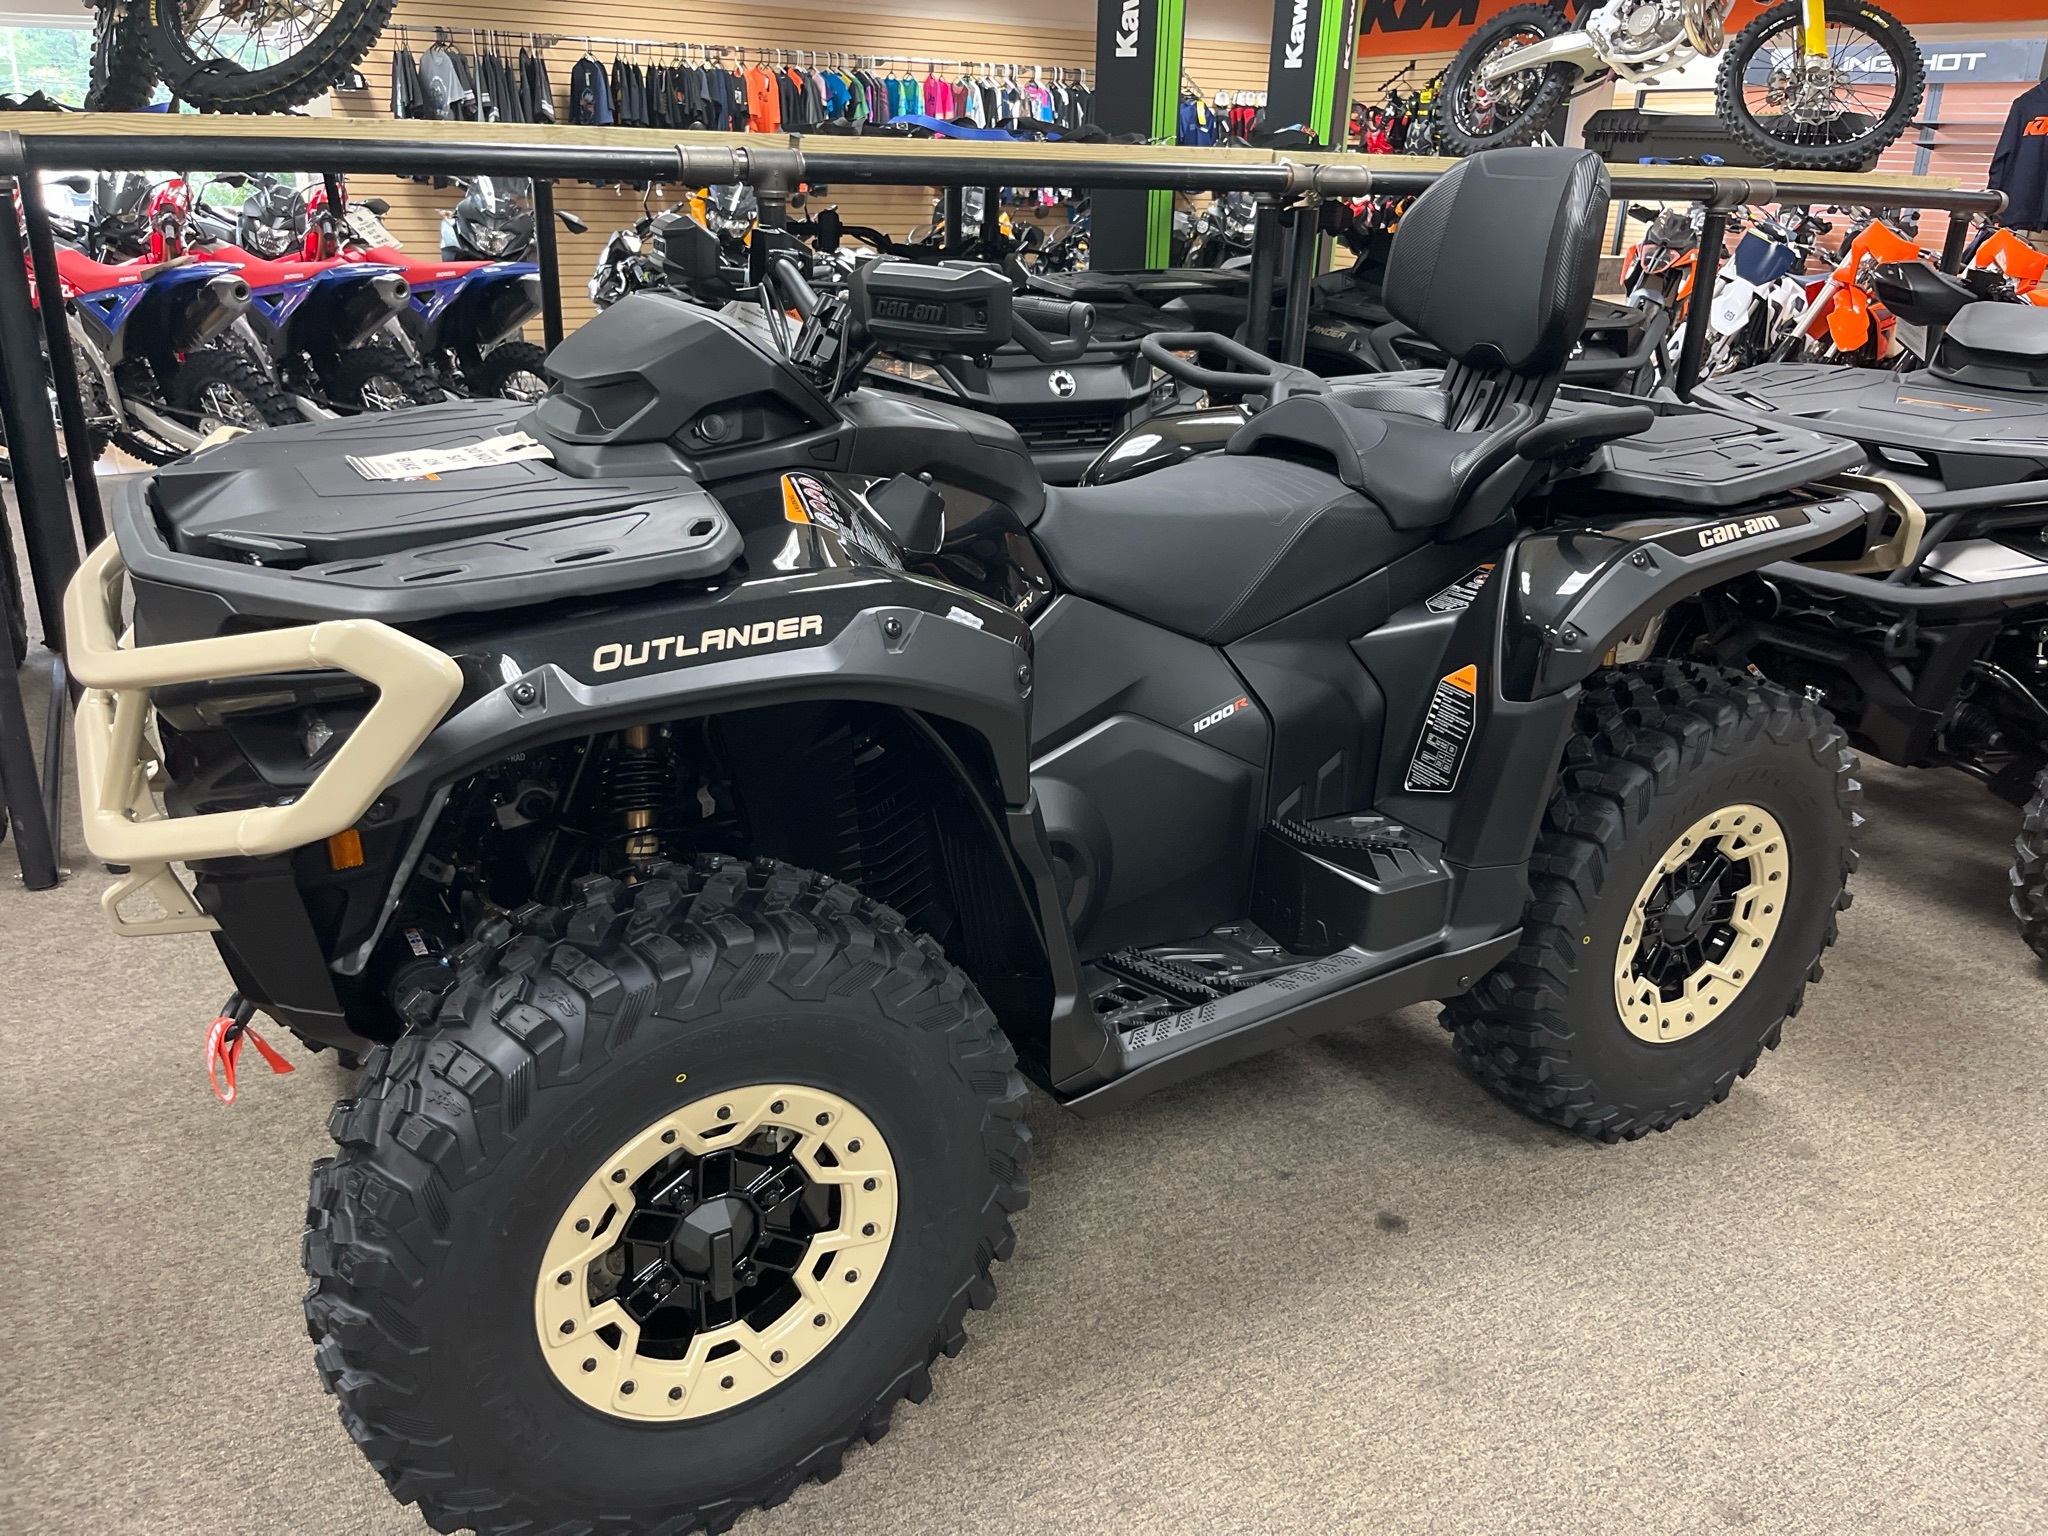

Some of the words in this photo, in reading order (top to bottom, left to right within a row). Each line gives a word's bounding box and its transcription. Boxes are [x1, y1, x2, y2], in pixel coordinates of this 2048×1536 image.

[1360, 0, 1480, 35] KTM
[2022, 116, 2048, 137] KT
[876, 300, 945, 321] can-am
[1697, 515, 1781, 548] can-am
[592, 614, 823, 673] OUTLANDER
[1193, 697, 1249, 734] 1000R
